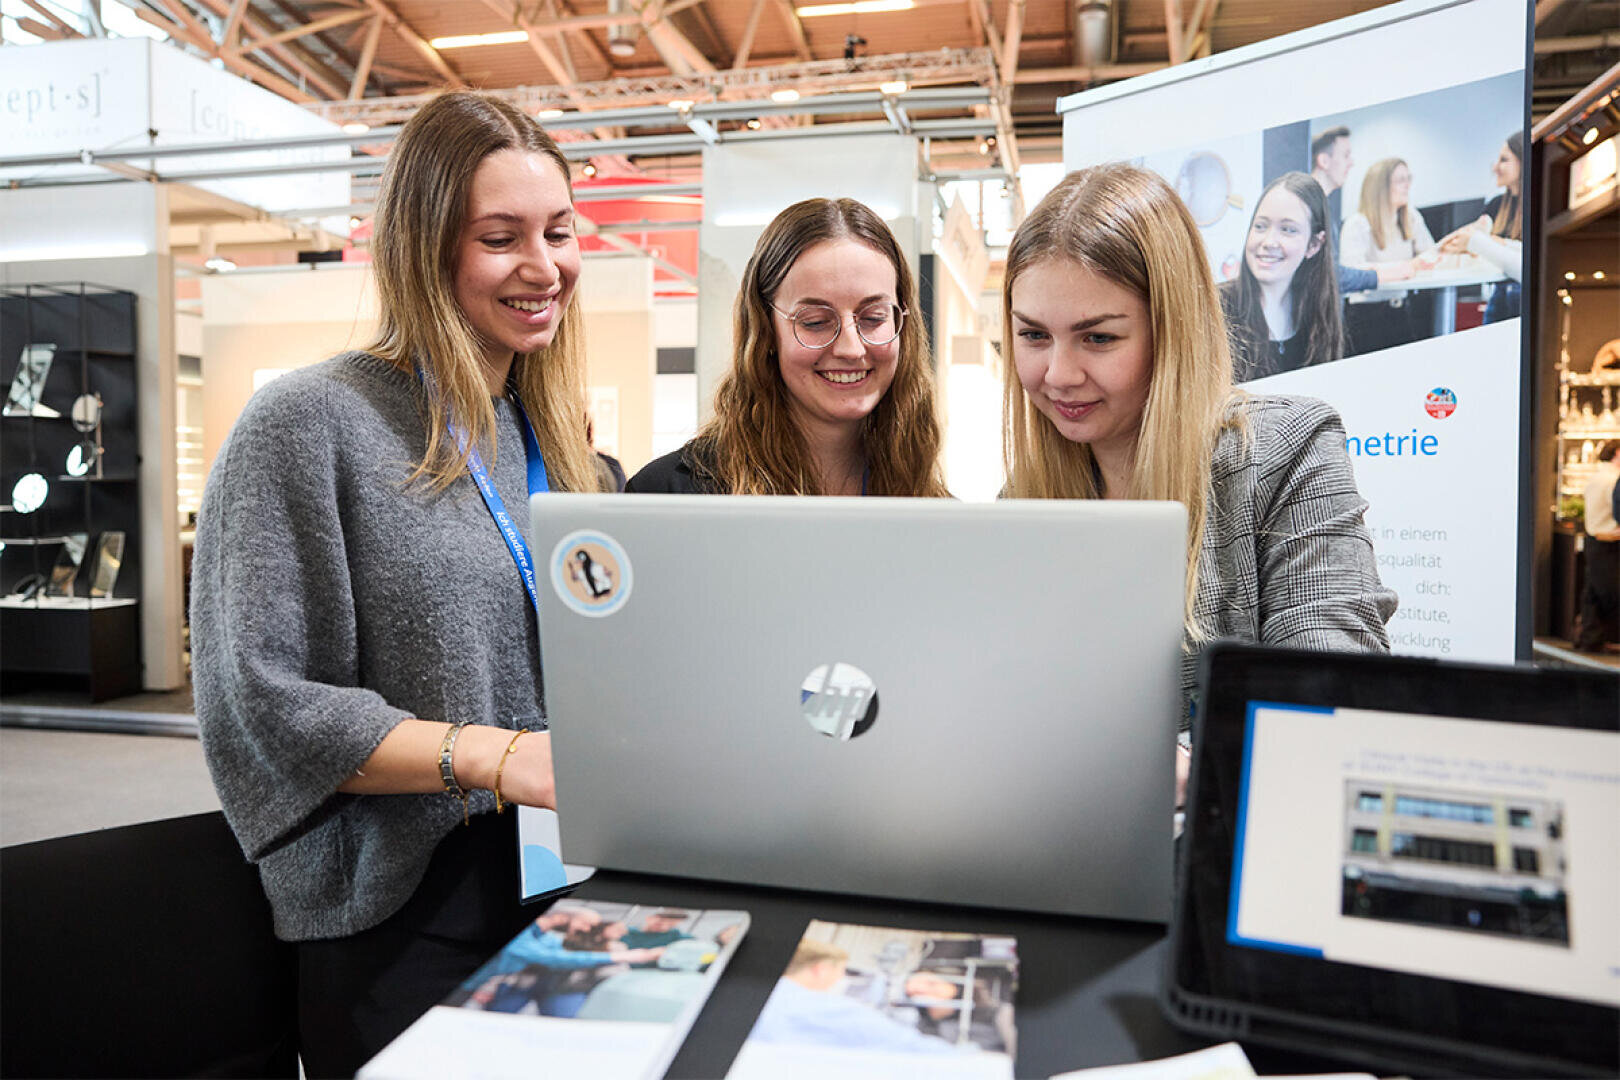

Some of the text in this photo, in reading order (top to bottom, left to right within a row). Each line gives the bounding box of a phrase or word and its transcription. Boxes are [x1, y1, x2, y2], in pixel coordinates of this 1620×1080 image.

[1382, 525, 1394, 540] in
[1400, 525, 1448, 541] einem
[1396, 606, 1451, 625] stitute,
